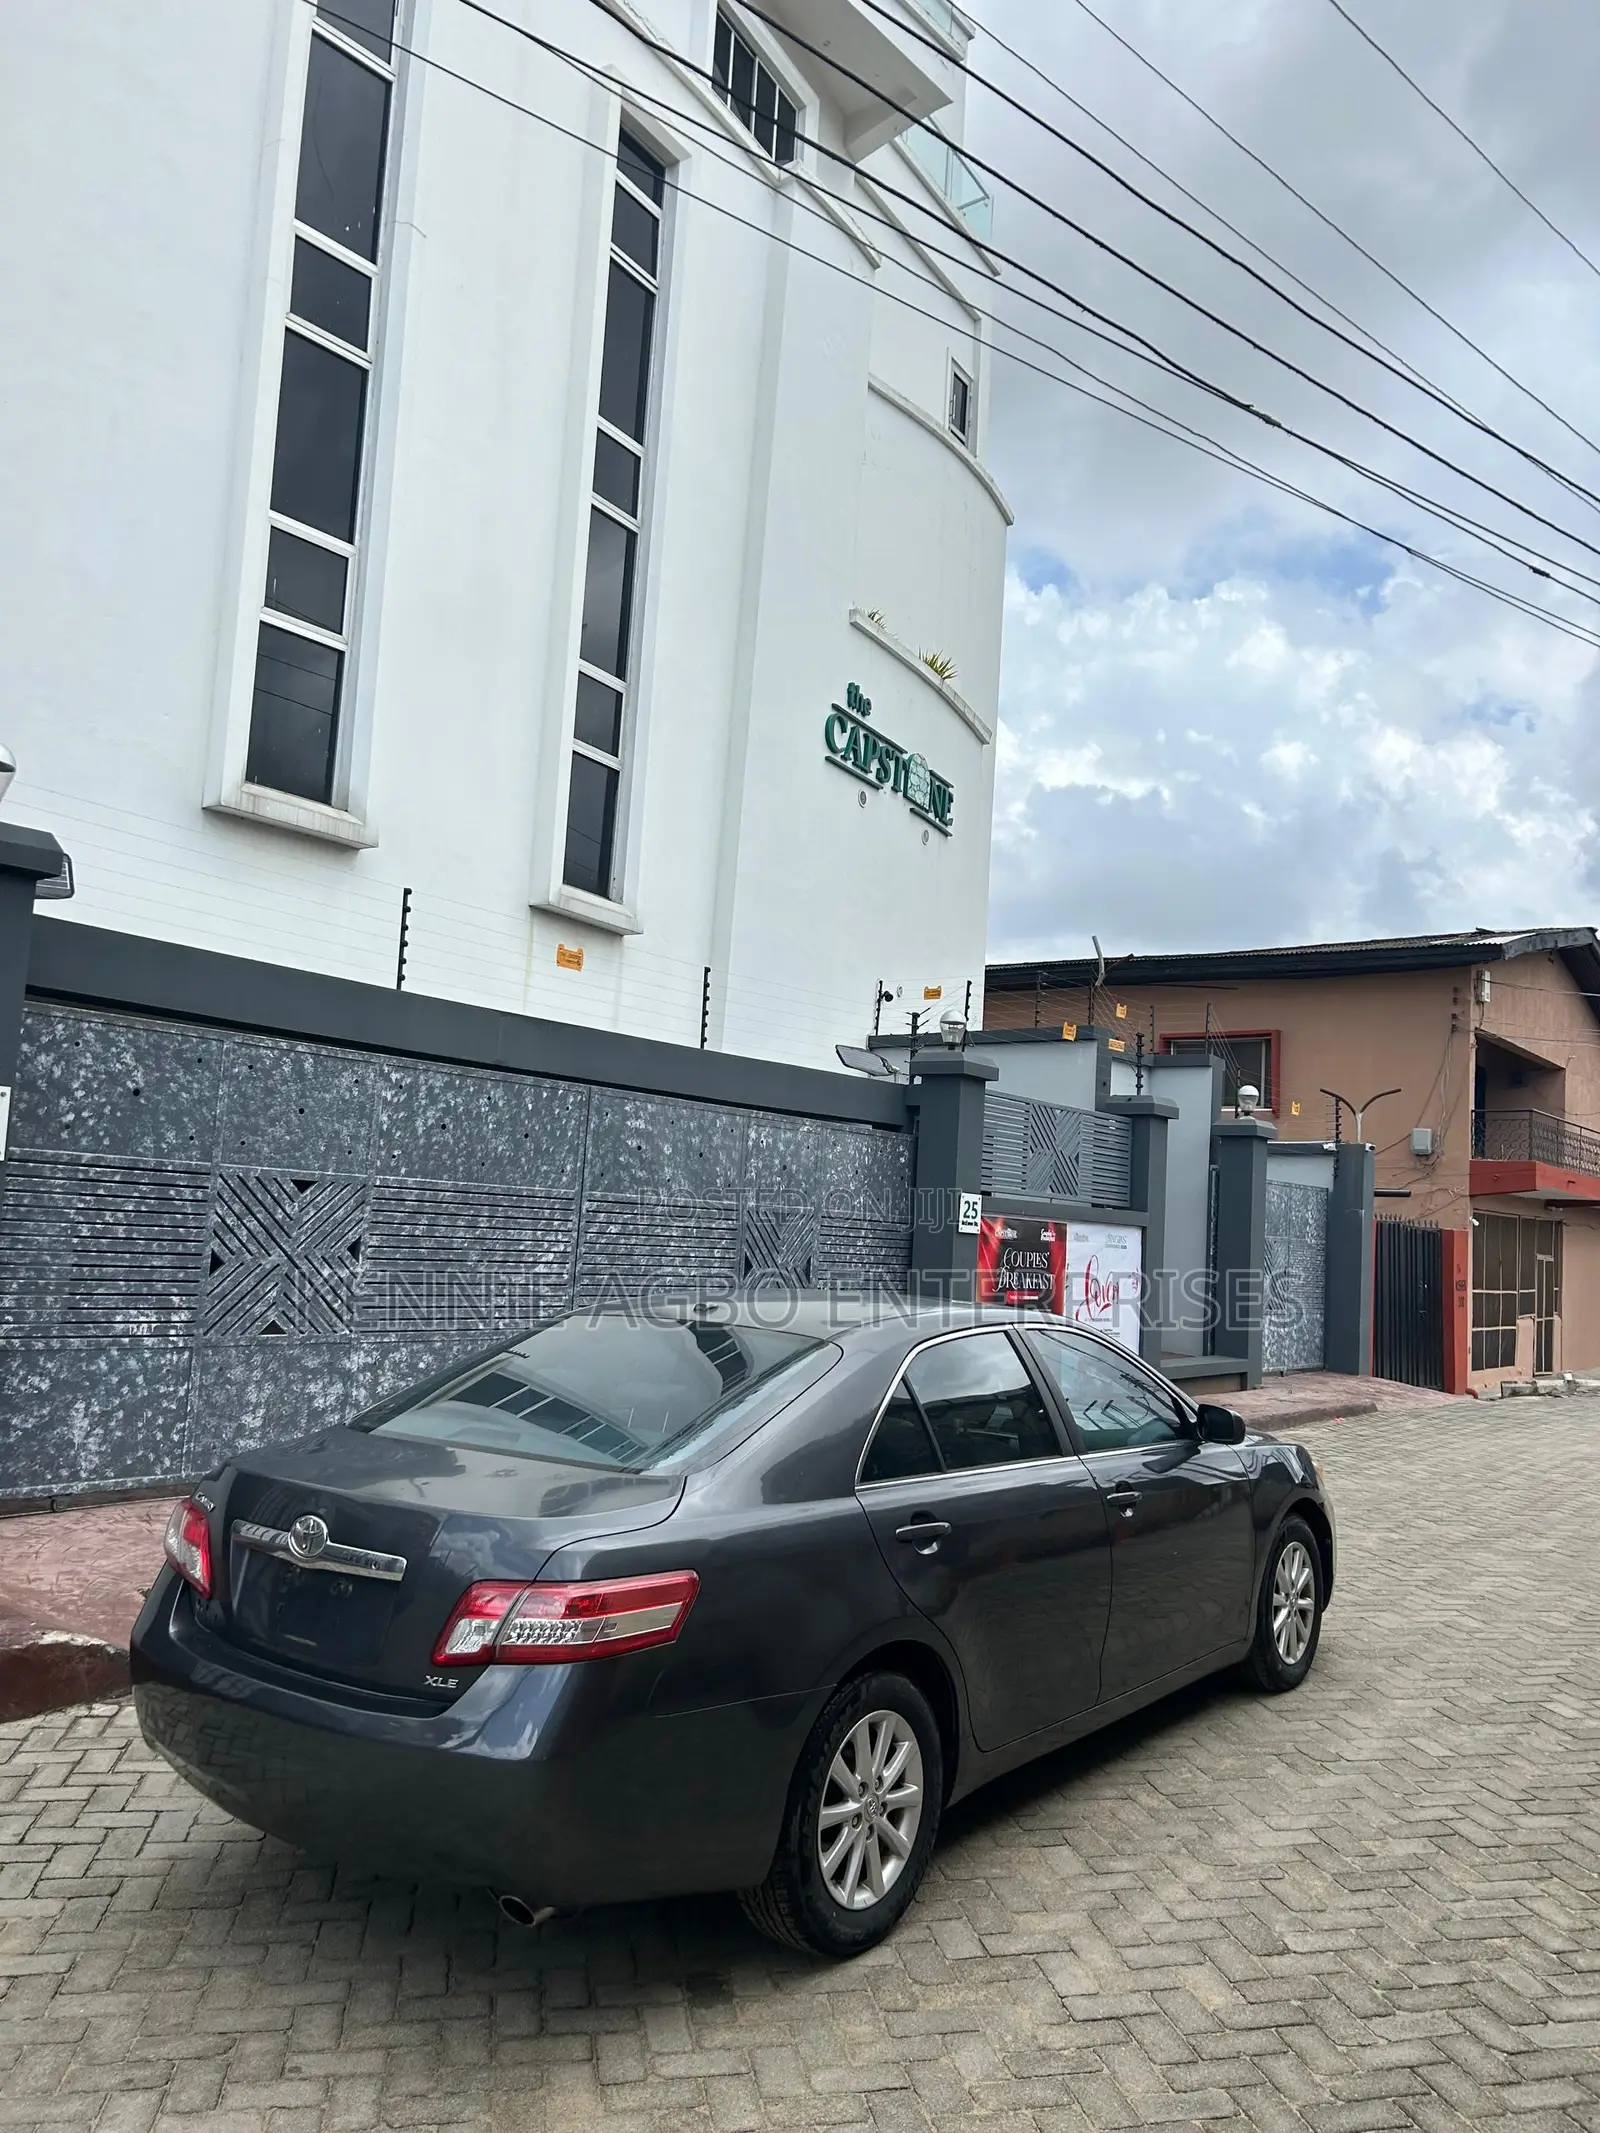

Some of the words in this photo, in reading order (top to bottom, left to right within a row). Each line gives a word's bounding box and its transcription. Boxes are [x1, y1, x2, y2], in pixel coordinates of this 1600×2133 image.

[847, 682, 872, 717] the
[963, 1200, 978, 1220] 25
[992, 1267, 1054, 1292] BREAKFAST
[423, 1675, 459, 1689] XLE
